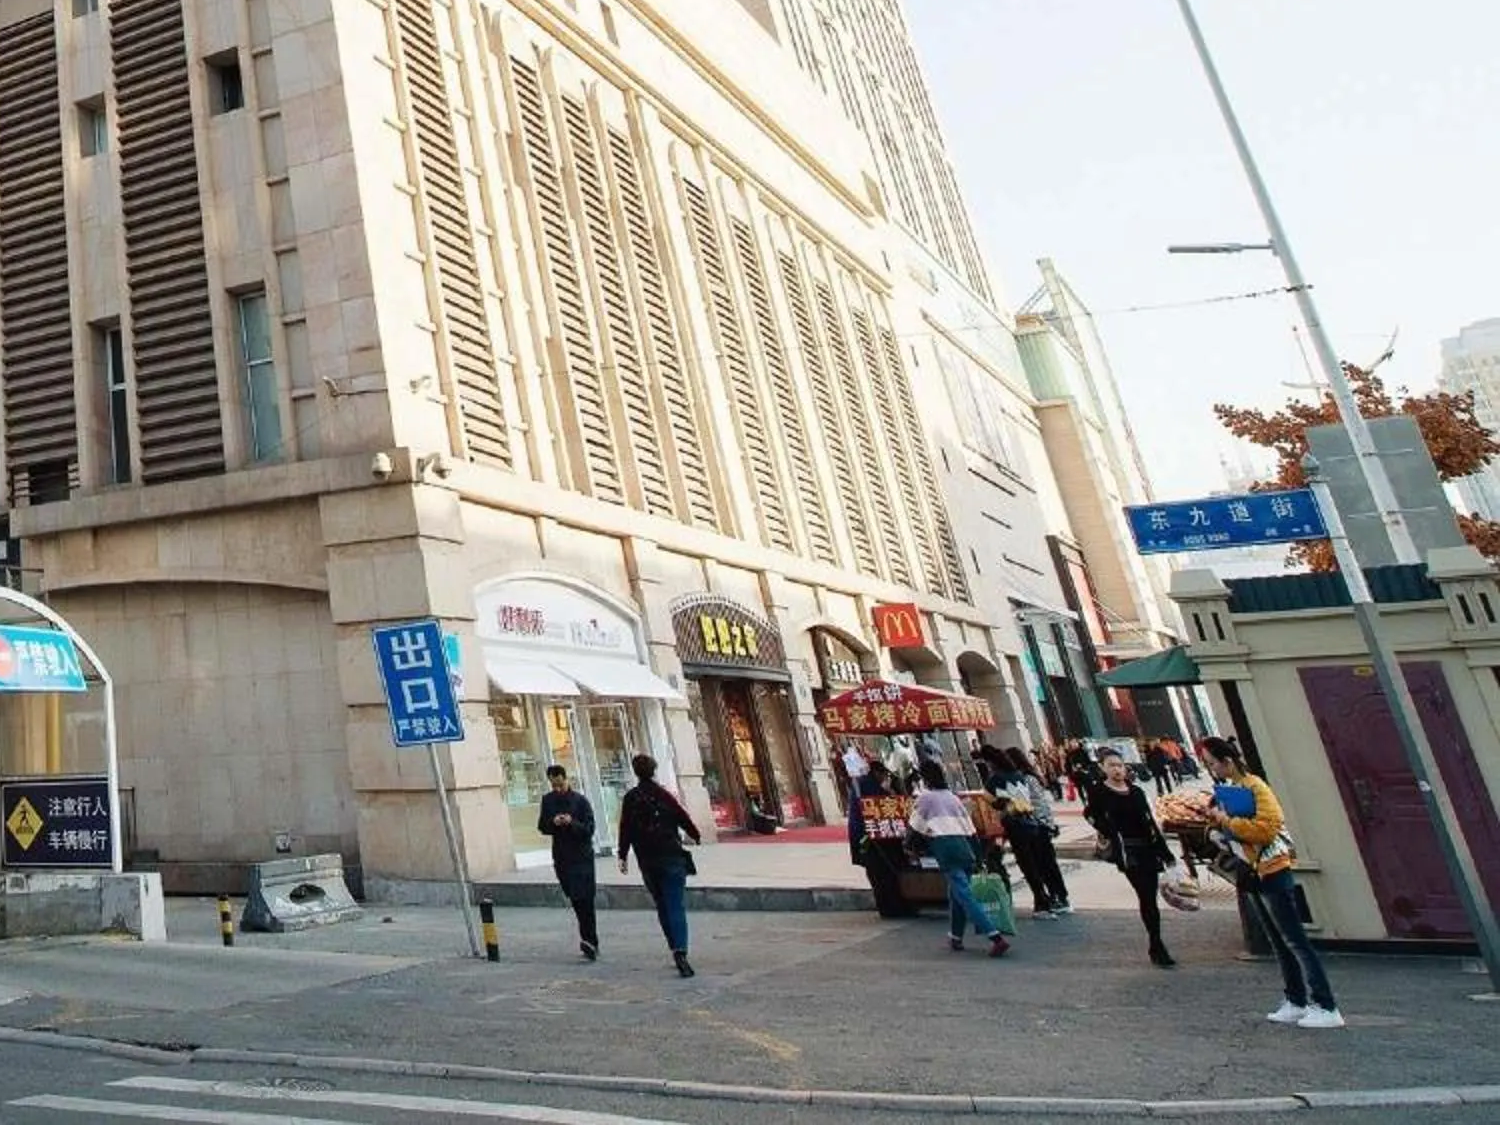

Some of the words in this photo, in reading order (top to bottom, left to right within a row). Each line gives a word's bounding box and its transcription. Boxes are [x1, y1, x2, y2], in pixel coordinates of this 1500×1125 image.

[12, 640, 81, 676] 严禁驶入
[390, 630, 439, 714] 出口
[823, 699, 951, 731] 马家烤冷面
[48, 796, 108, 816] 注意行人
[48, 829, 109, 851] 车辆慢行
